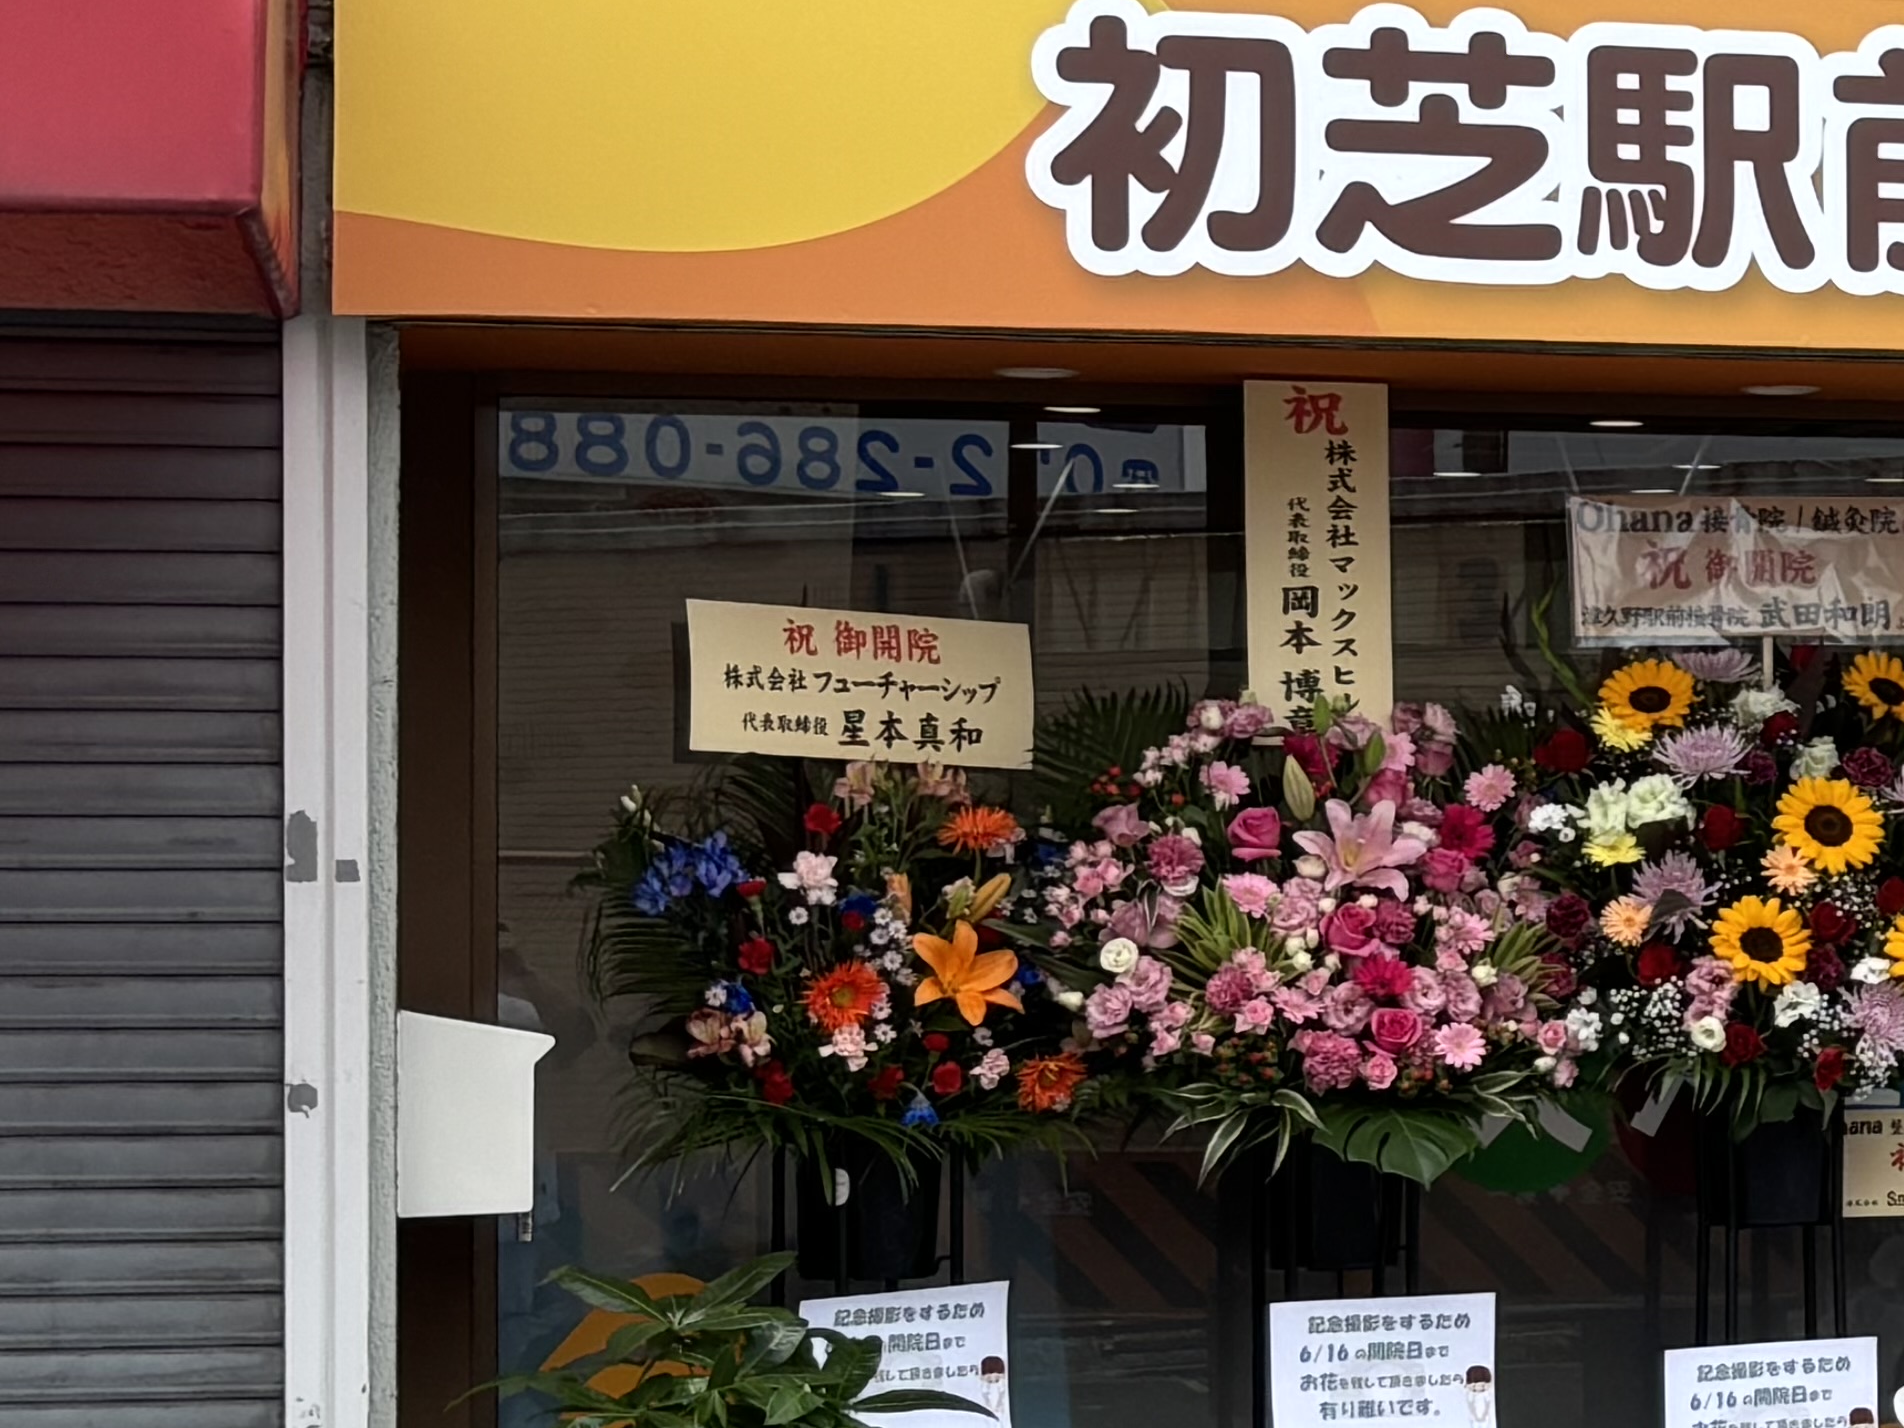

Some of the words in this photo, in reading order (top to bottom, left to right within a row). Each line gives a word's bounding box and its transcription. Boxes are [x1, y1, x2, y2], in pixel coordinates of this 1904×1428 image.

[1283, 385, 1348, 436] 祝
[1324, 440, 1360, 548] 株式会社
[783, 618, 819, 657] 祝
[834, 619, 943, 665] 御開院
[1280, 585, 1323, 655] 岡本
[723, 663, 809, 693] 株式会社
[813, 669, 1002, 705] フューチャーシップ
[836, 709, 984, 753] 星本真和
[1307, 1312, 1472, 1335] 記念撮影をするため
[1299, 1343, 1350, 1365] 6/16
[1695, 1355, 1852, 1384] 記念撮影をするため
[1689, 1390, 1738, 1412] 6/16
